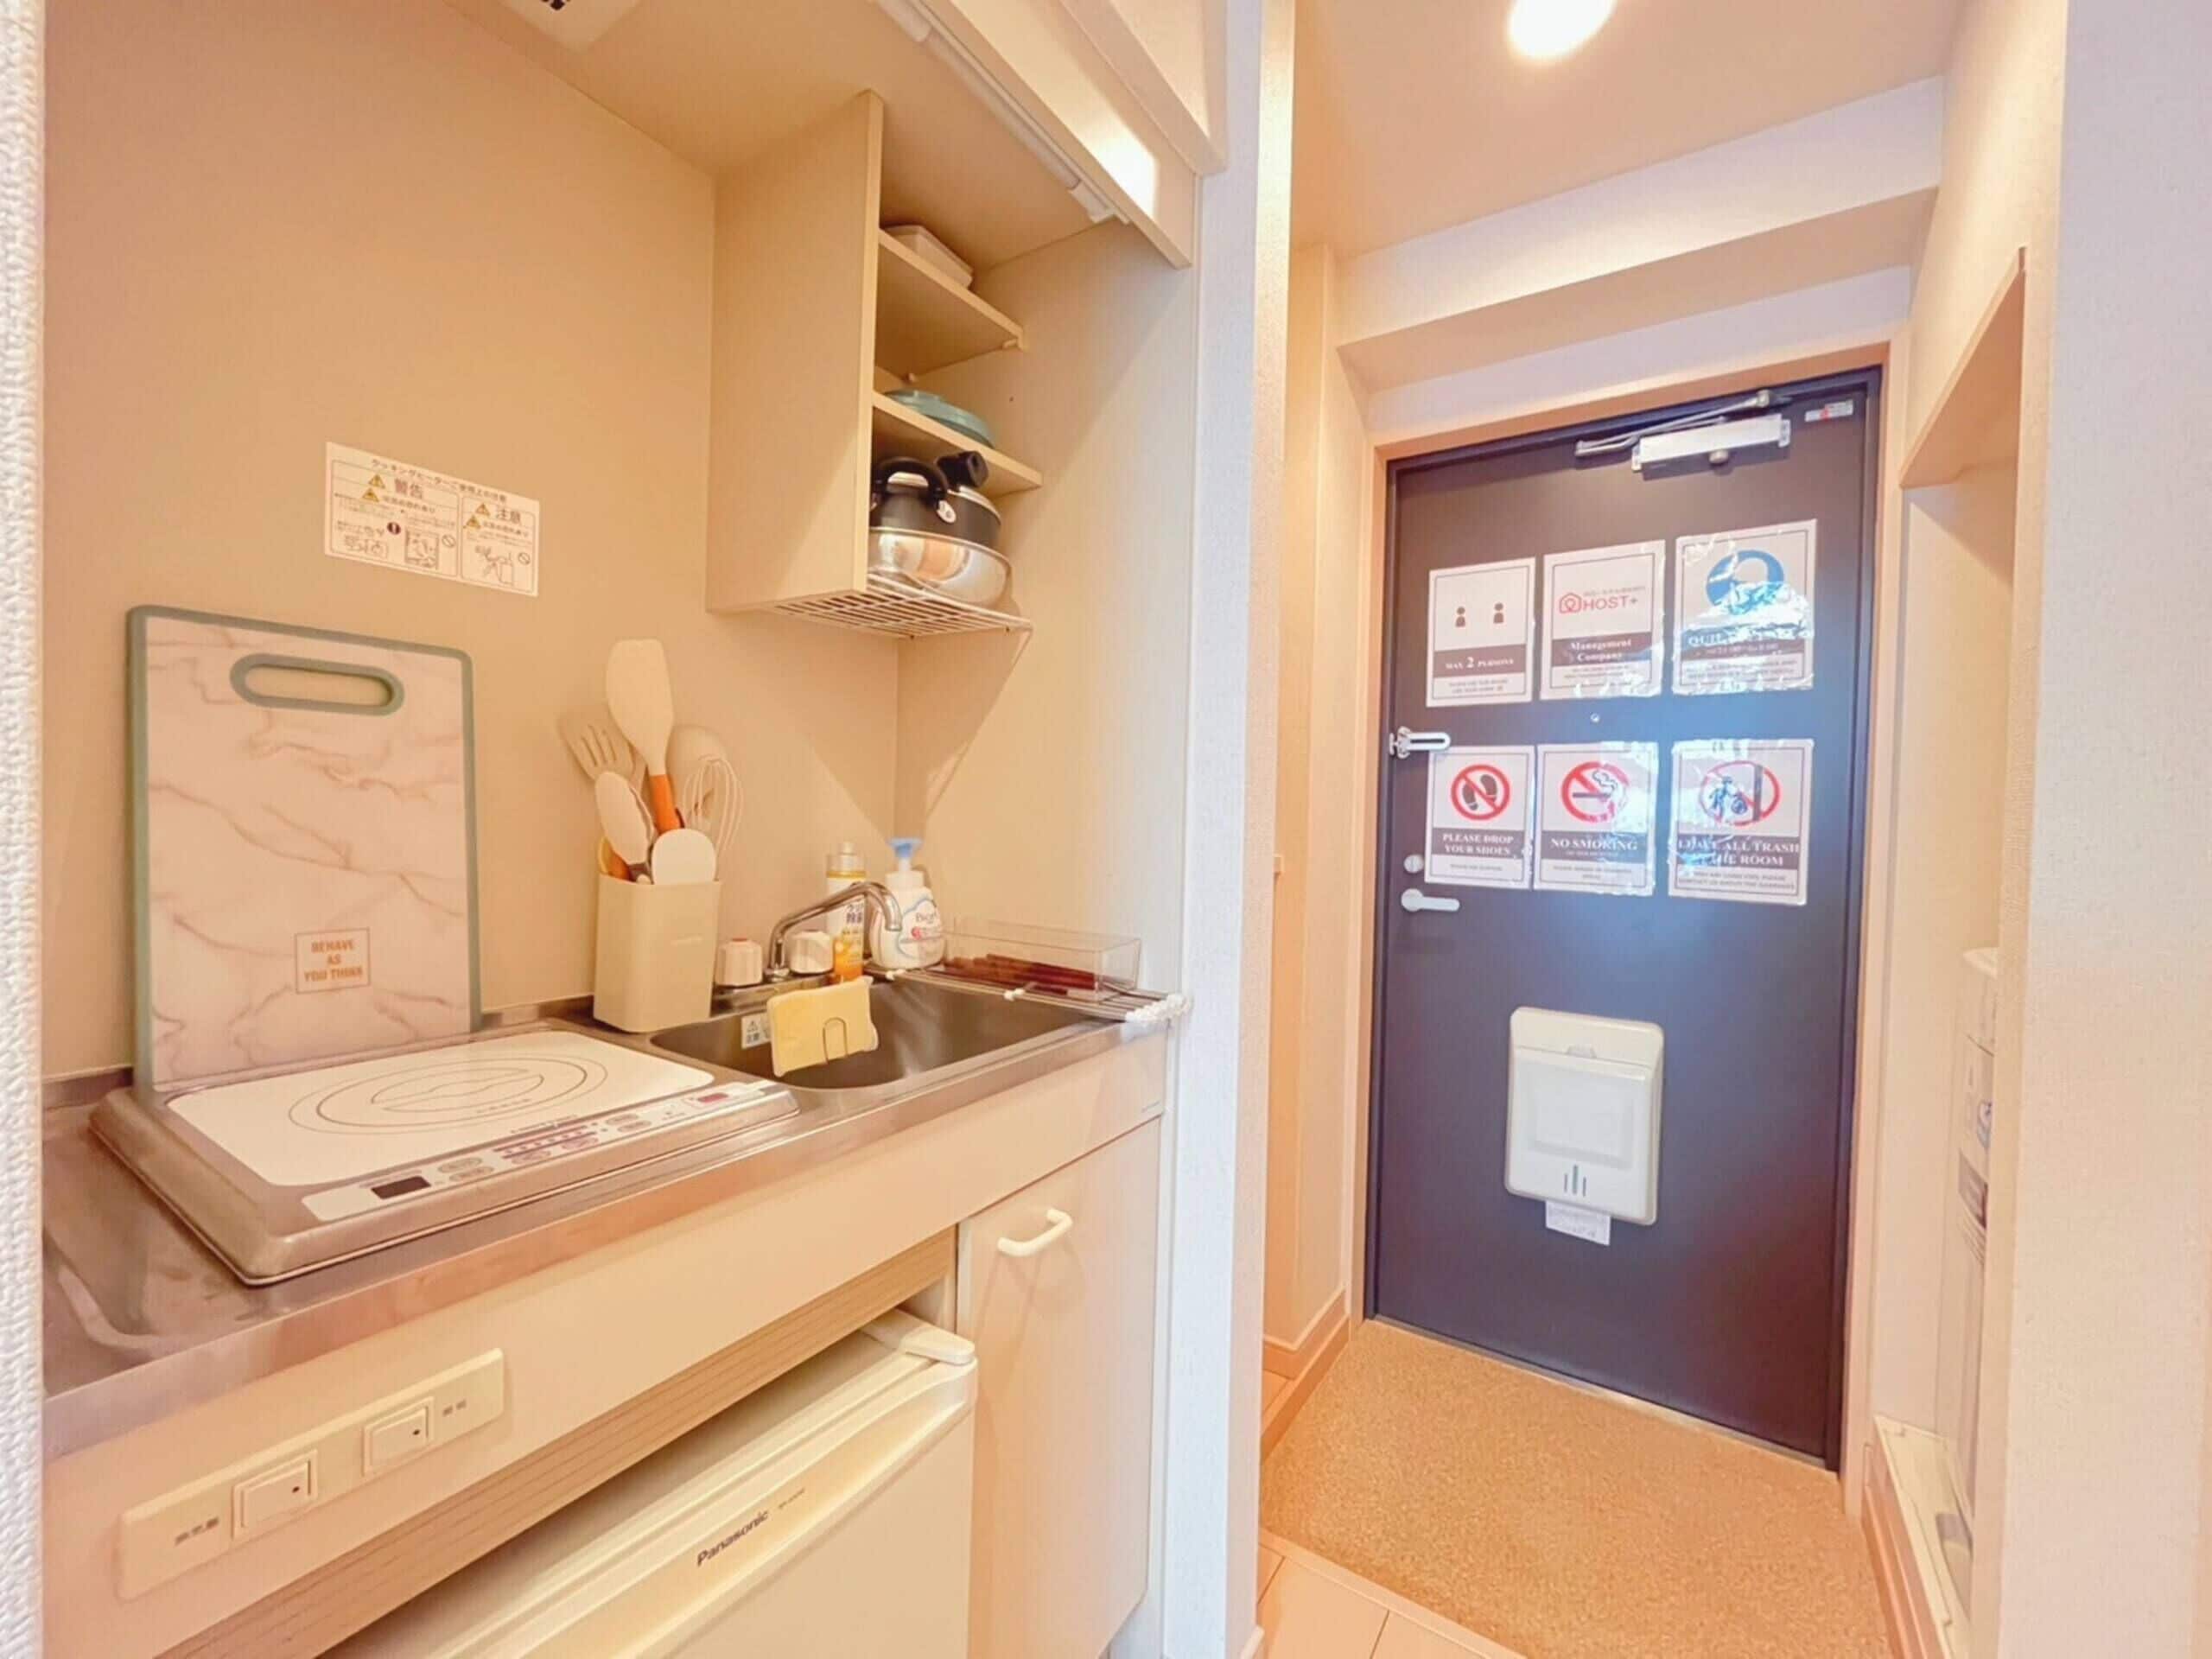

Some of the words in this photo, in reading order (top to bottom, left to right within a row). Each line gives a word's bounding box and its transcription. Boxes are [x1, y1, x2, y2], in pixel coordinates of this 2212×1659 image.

[1571, 639, 1632, 652] Management
[1466, 657, 1475, 669] 2
[1578, 652, 1624, 663] Company
[1442, 833, 1480, 843] PLEASE
[1484, 835, 1515, 844] DROP
[1551, 838, 1570, 848] NO
[1573, 839, 1638, 851] SMOKING
[1445, 844, 1473, 854] YOUR
[1476, 846, 1511, 855] SHOES
[1723, 841, 1751, 852] ALL
[1752, 841, 1801, 854] TRASH
[1740, 855, 1784, 866] ROOM
[311, 939, 354, 953] BEHAVE
[327, 953, 341, 965] AS
[304, 969, 327, 982] YOU
[331, 965, 364, 980] THINK
[697, 1510, 768, 1567] Panasonic
